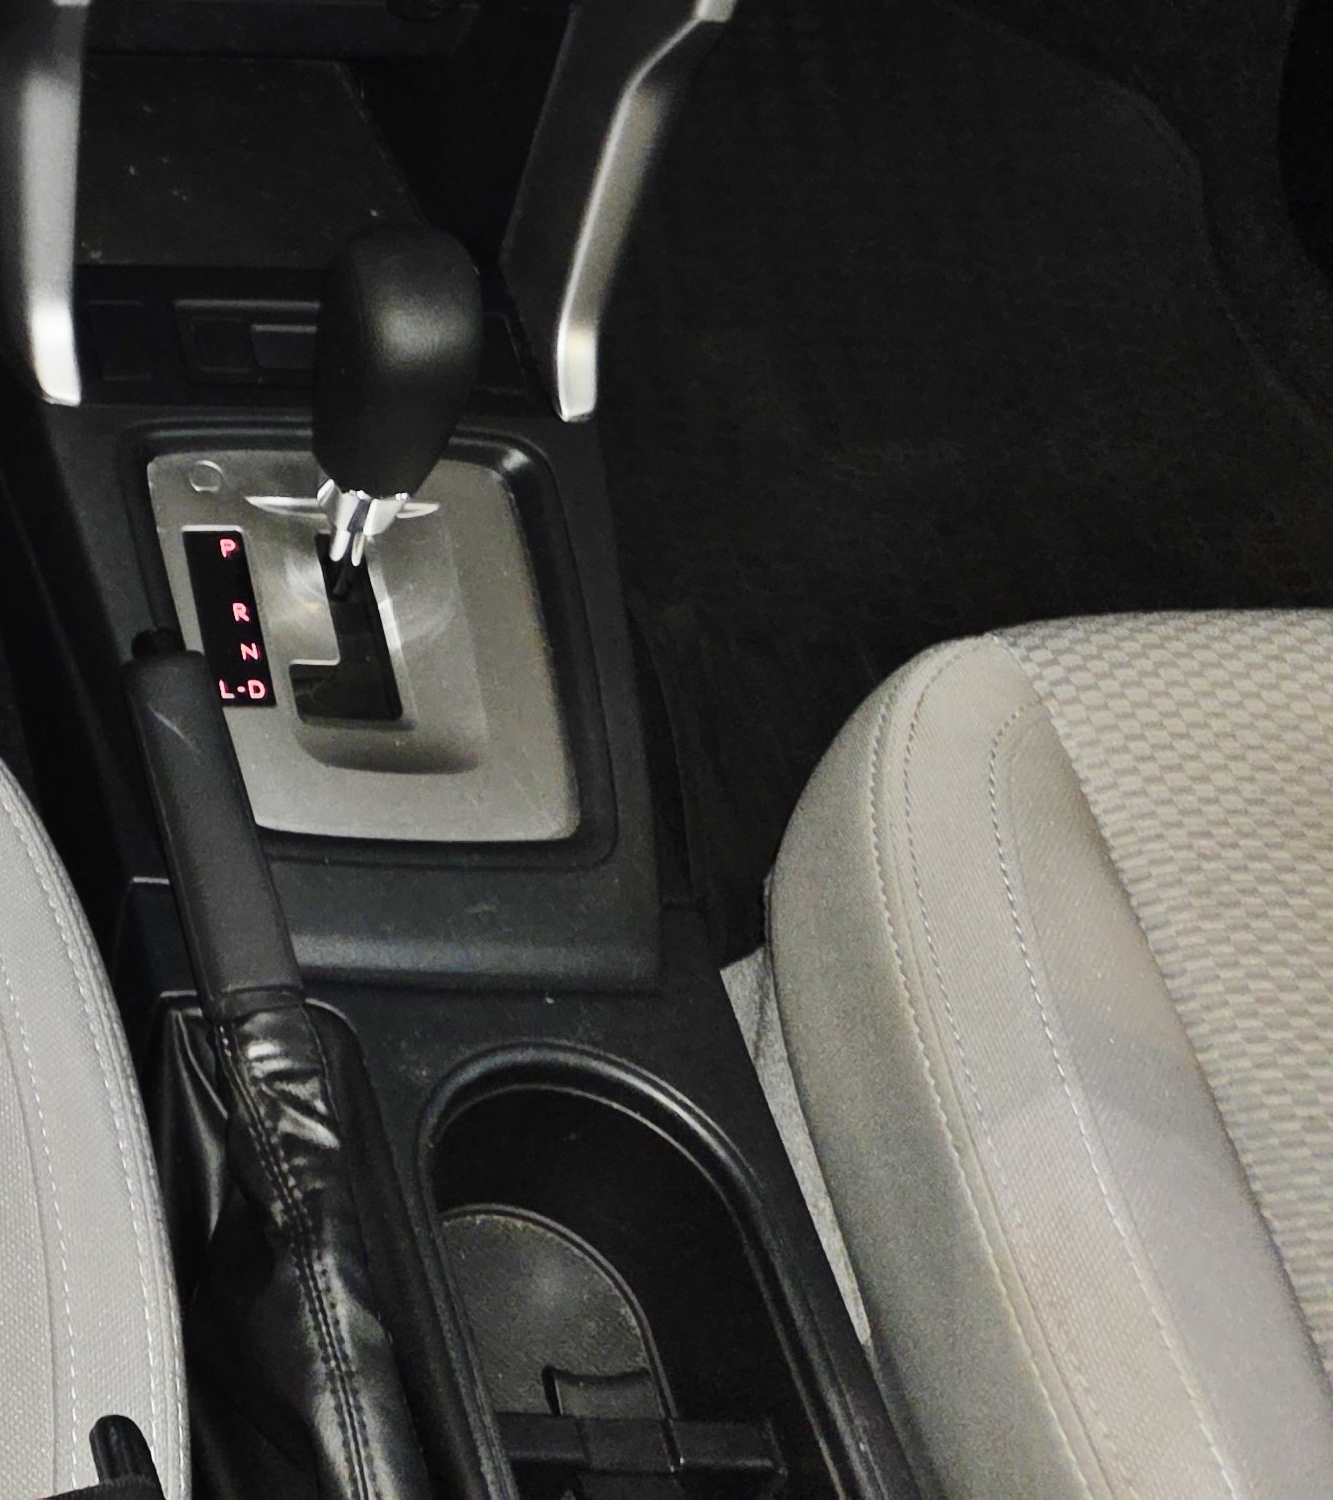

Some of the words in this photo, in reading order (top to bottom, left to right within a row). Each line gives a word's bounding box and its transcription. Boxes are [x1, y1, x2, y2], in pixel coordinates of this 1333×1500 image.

[219, 539, 237, 557] P
[233, 603, 249, 622] R
[240, 643, 259, 660] N
